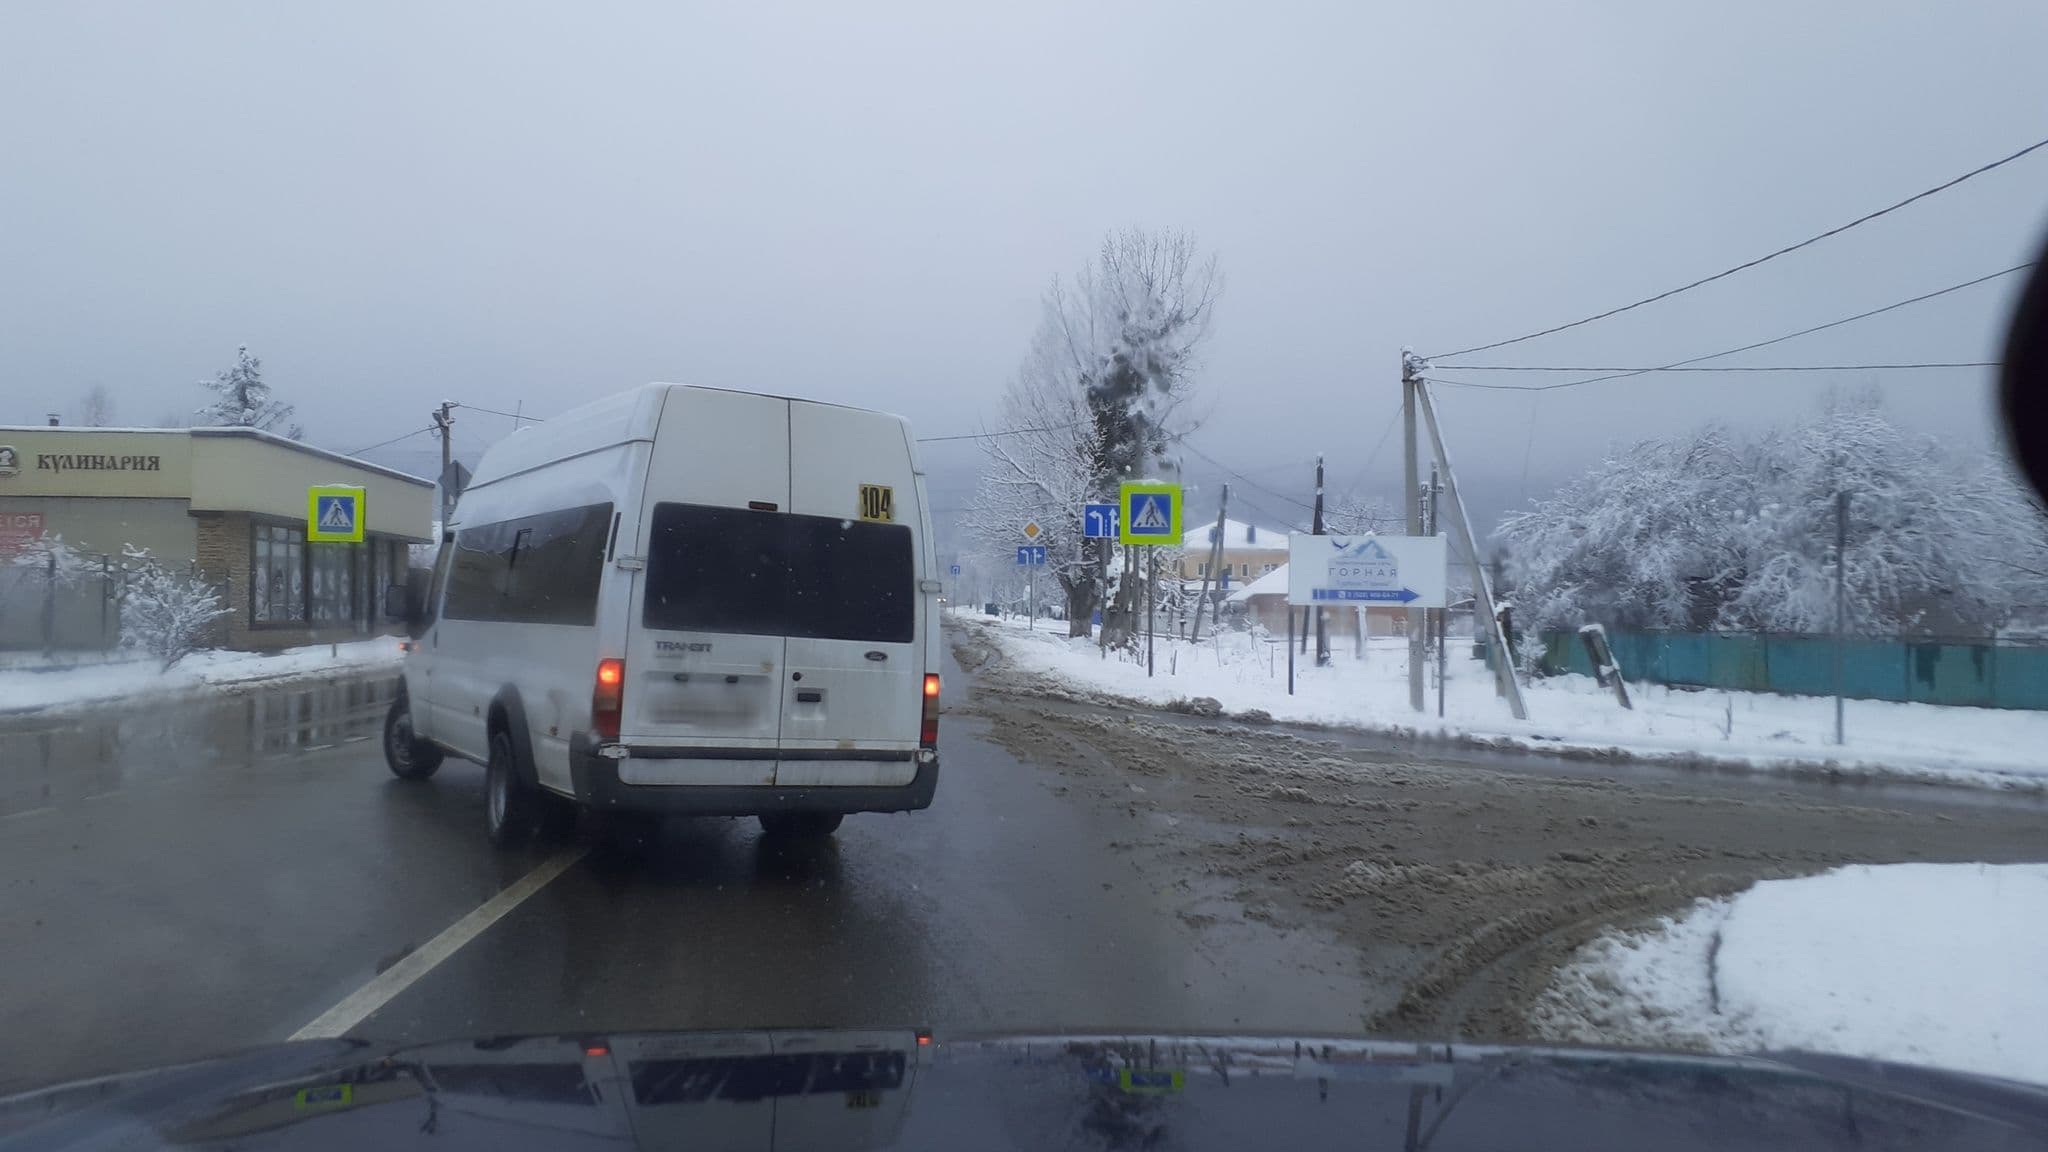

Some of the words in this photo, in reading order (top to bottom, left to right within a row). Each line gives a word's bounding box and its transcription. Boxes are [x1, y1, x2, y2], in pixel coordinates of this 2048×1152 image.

[37, 454, 161, 473] КУЛИНАРИЯ
[862, 486, 891, 519] 104
[1328, 567, 1398, 577] ГОРНАЯ
[655, 640, 713, 653] TRANSIT
